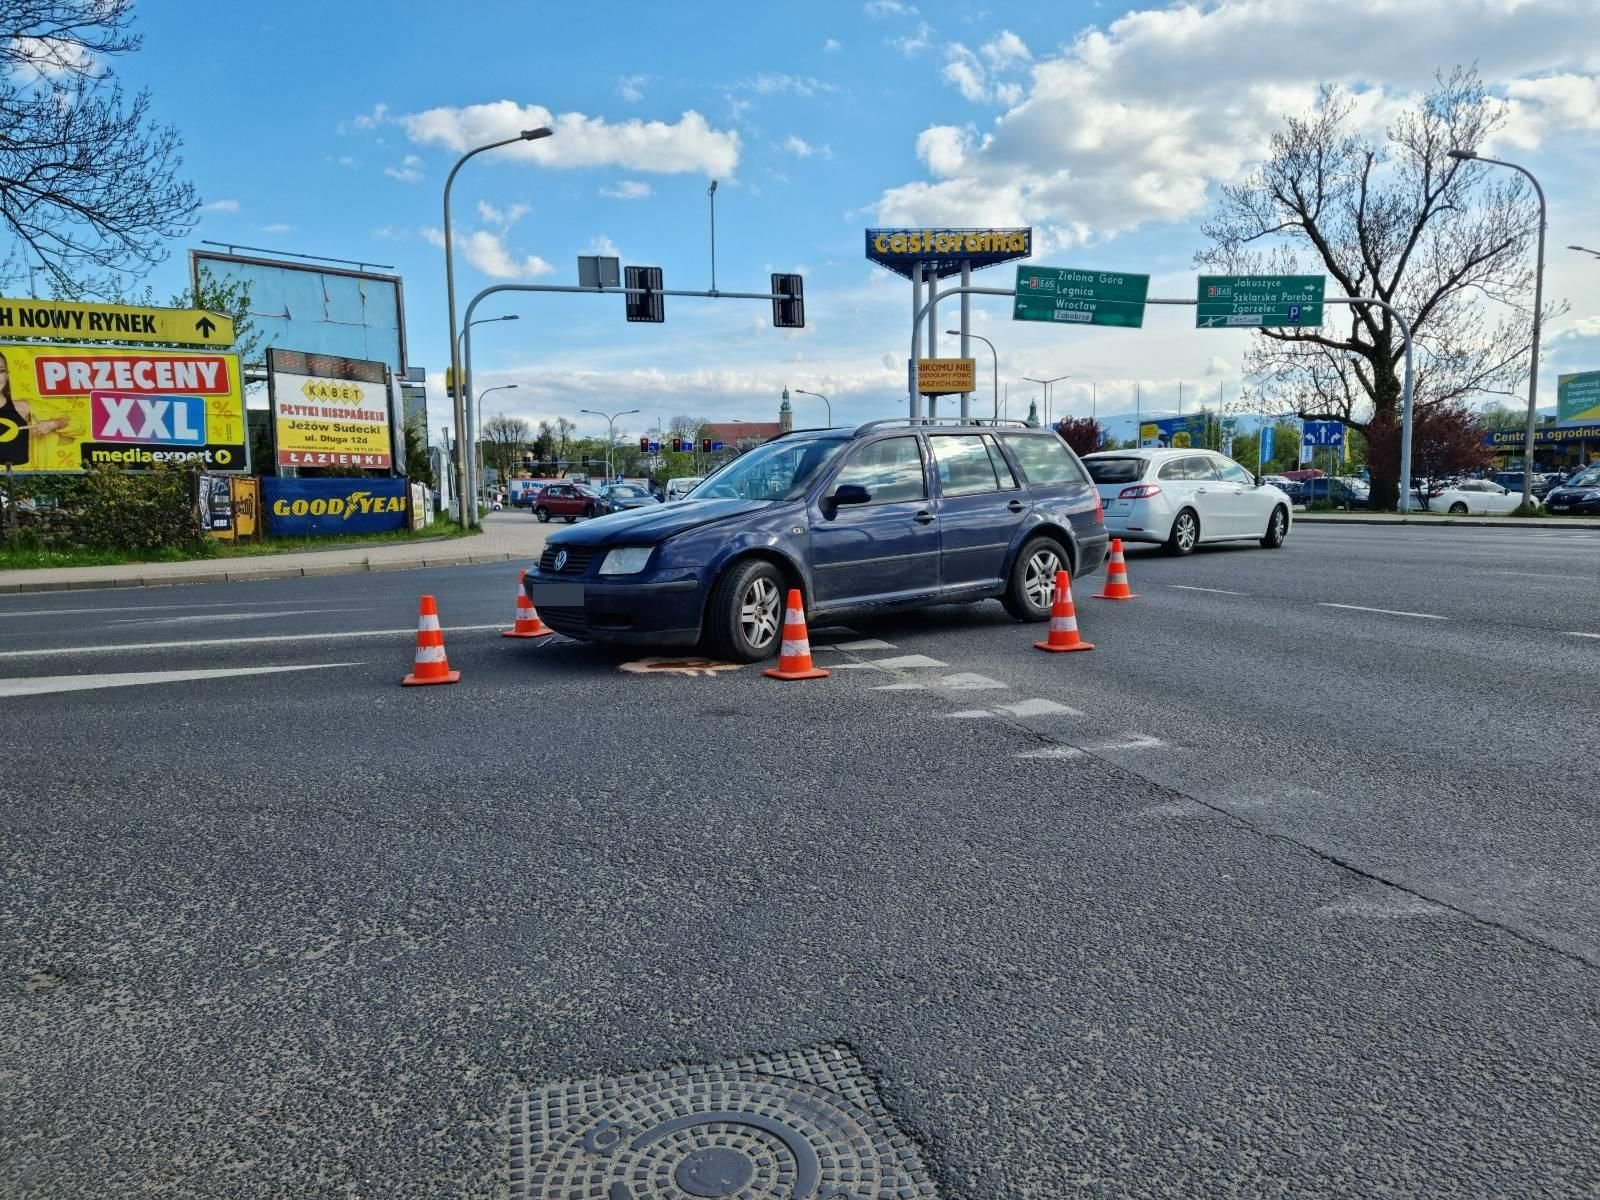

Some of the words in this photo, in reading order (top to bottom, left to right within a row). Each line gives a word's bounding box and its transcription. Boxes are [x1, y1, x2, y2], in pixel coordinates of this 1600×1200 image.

[875, 231, 1025, 253] castorama
[1031, 278, 1037, 287] 3
[1040, 279, 1053, 289] E65
[1058, 270, 1094, 283] Zielona
[1099, 273, 1124, 285] Góra
[1234, 279, 1281, 289] Jakuszyce
[1056, 285, 1094, 297] Legnica
[1209, 287, 1215, 295] 3
[1218, 287, 1231, 296] E65
[1232, 292, 1277, 302] Szklarska
[1055, 298, 1097, 311] Wrocław
[1232, 303, 1276, 316] Zgorzelec
[0, 307, 13, 327] H
[19, 308, 84, 330] NOWY
[88, 312, 157, 334] RYNEK
[956, 363, 972, 371] NIE
[42, 361, 220, 391] PRZECENY
[308, 384, 360, 399] KABET
[280, 403, 319, 417] PŁYTKI
[100, 397, 199, 440] XXL
[287, 420, 330, 431] Jeżów
[333, 423, 381, 435] Sudecki
[304, 434, 318, 442] ul.
[320, 435, 348, 445] Długa
[351, 436, 368, 444] 12d
[1493, 432, 1543, 442] Centrm
[92, 448, 213, 466] mediaexpert
[289, 451, 382, 465] ŁAZIENKI
